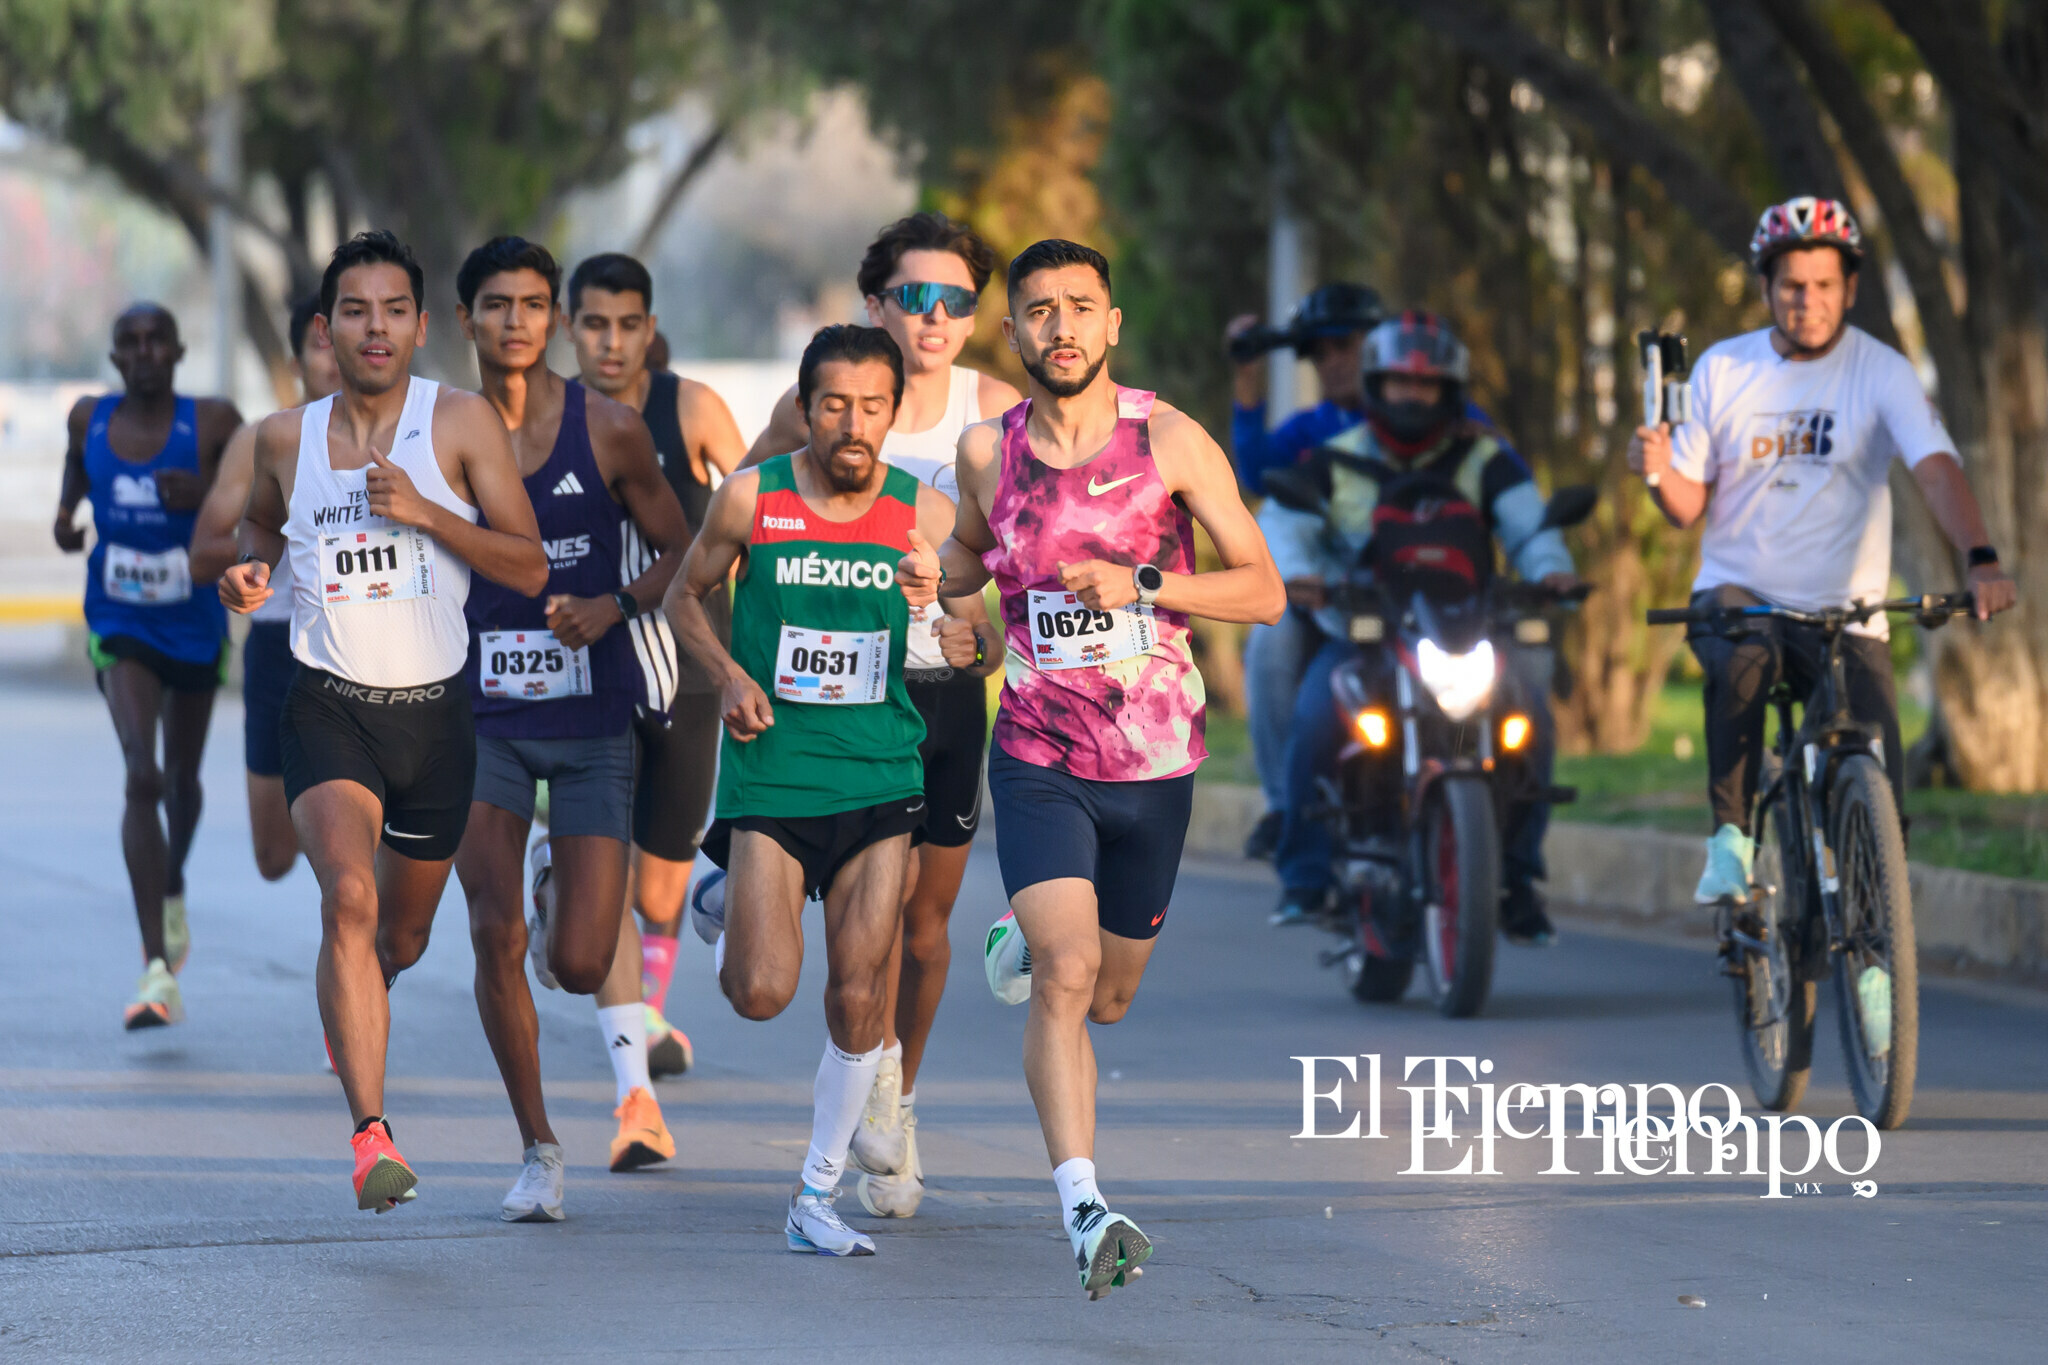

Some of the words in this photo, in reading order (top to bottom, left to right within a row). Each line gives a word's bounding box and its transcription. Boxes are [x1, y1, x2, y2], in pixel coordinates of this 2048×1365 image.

[347, 489, 370, 505] TEA
[313, 504, 363, 527] WHITE
[415, 538, 425, 551] KIT
[418, 553, 426, 563] de
[336, 544, 397, 576] 0111
[776, 552, 893, 590] MÉXICO
[420, 564, 429, 595] Entrega
[1037, 609, 1114, 639] 0625
[1135, 607, 1142, 618] de
[1138, 619, 1149, 651] Entrega
[491, 648, 563, 675] 0325
[791, 647, 858, 675] 0631
[903, 667, 954, 683] PRO
[323, 676, 388, 704] NIKE
[388, 684, 446, 705] PRO
